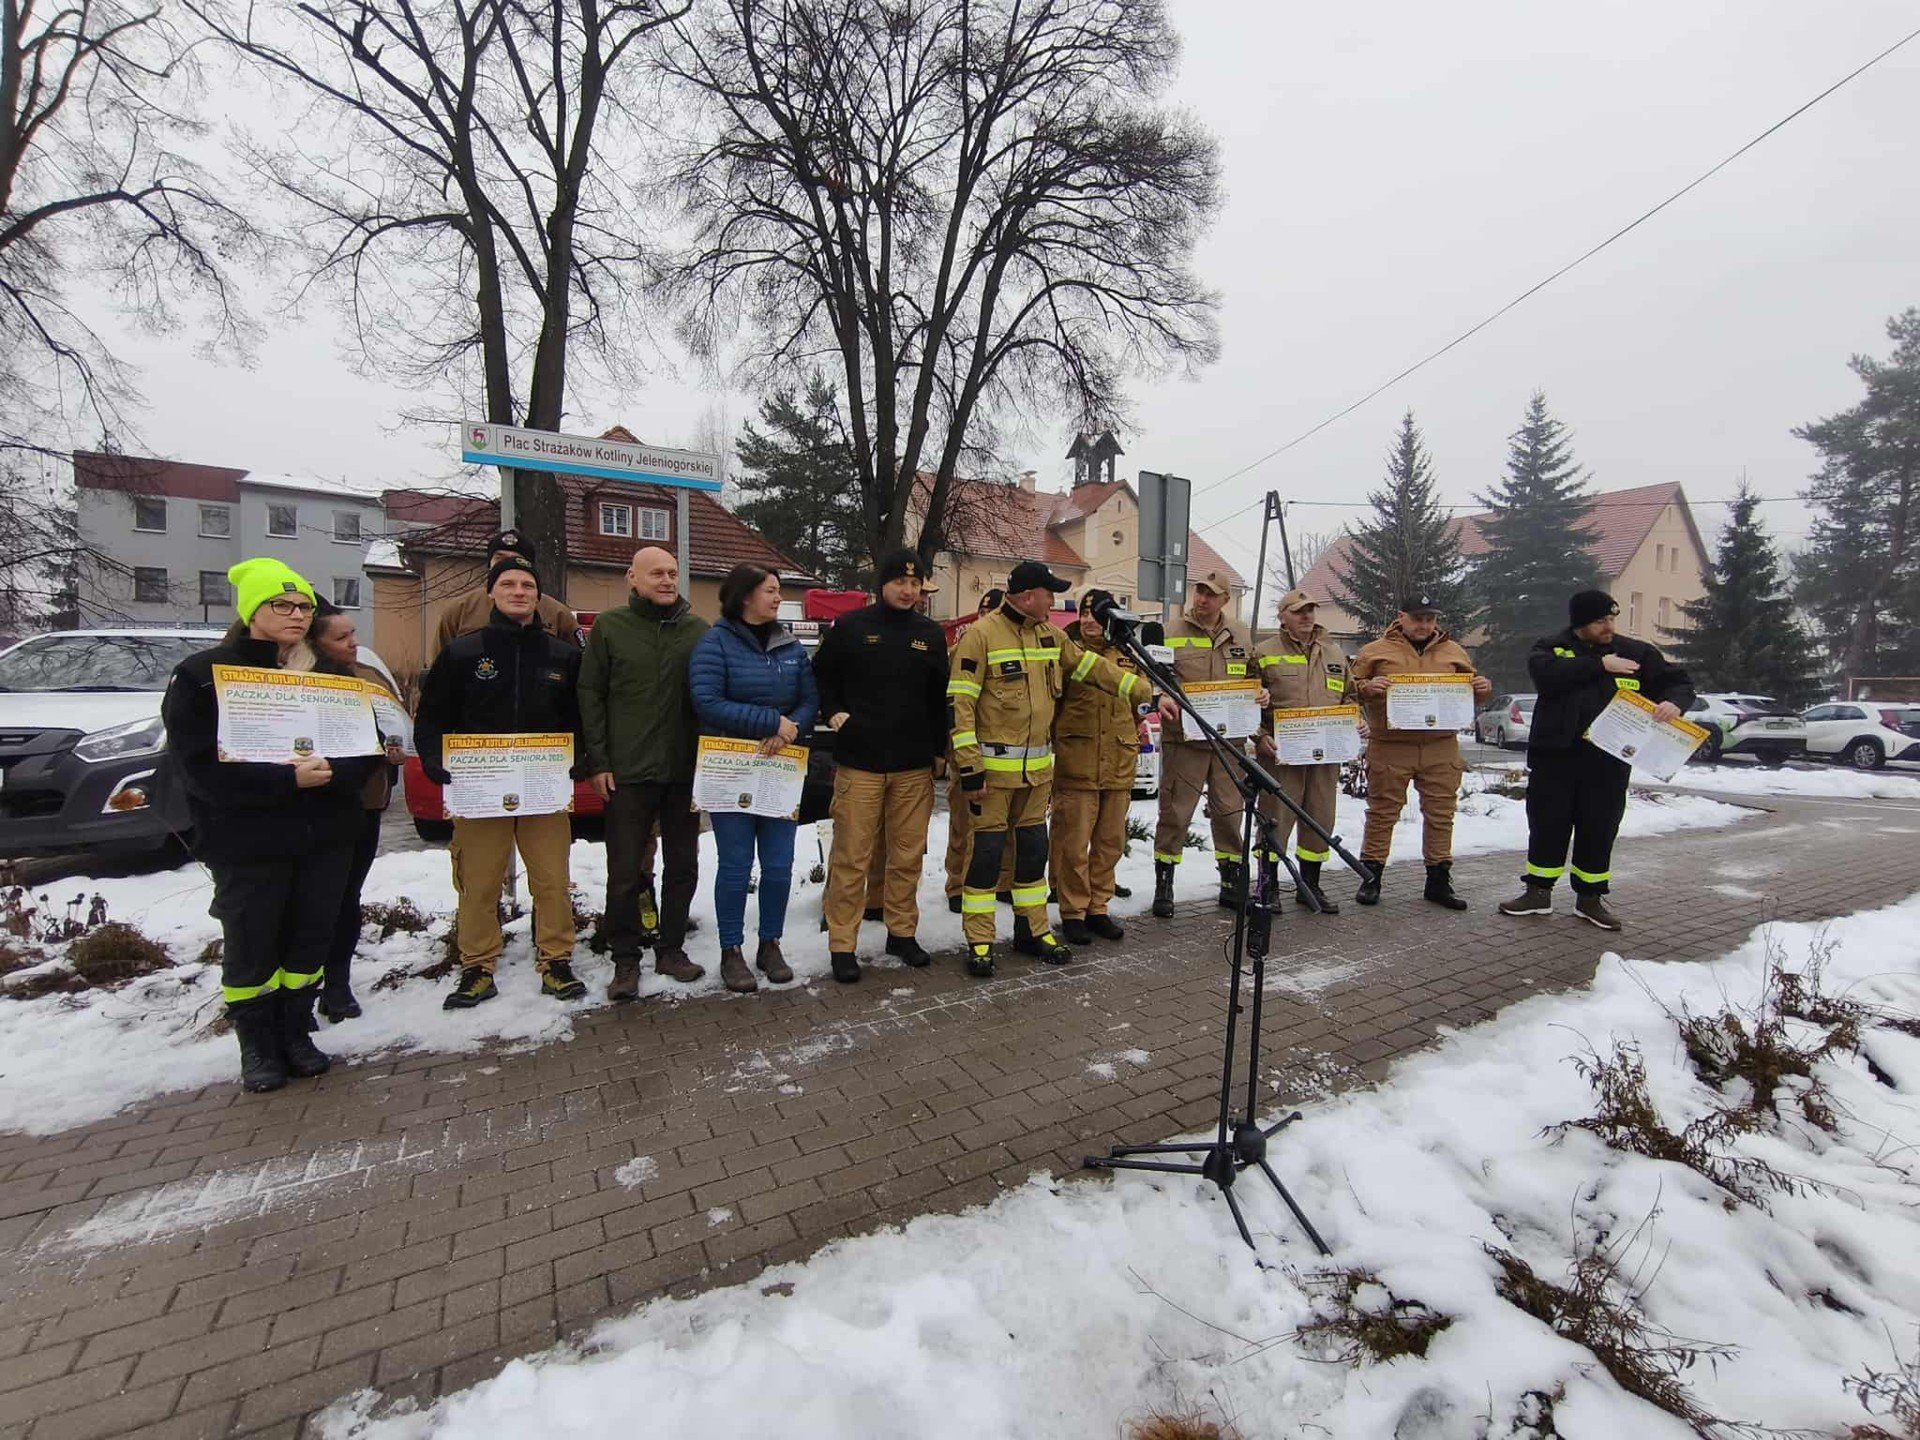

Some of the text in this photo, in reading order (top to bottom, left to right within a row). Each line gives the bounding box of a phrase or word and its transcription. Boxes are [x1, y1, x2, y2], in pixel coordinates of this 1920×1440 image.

[503, 434, 713, 477] Plac Strażaków Kotliny Jeleniogórskiej
[226, 689, 271, 700] PACZKA
[275, 692, 296, 701] DLA
[300, 694, 343, 704] SENIORA
[450, 755, 486, 764] PACZKA
[489, 755, 507, 763] DLA
[510, 754, 547, 763] SENIORA
